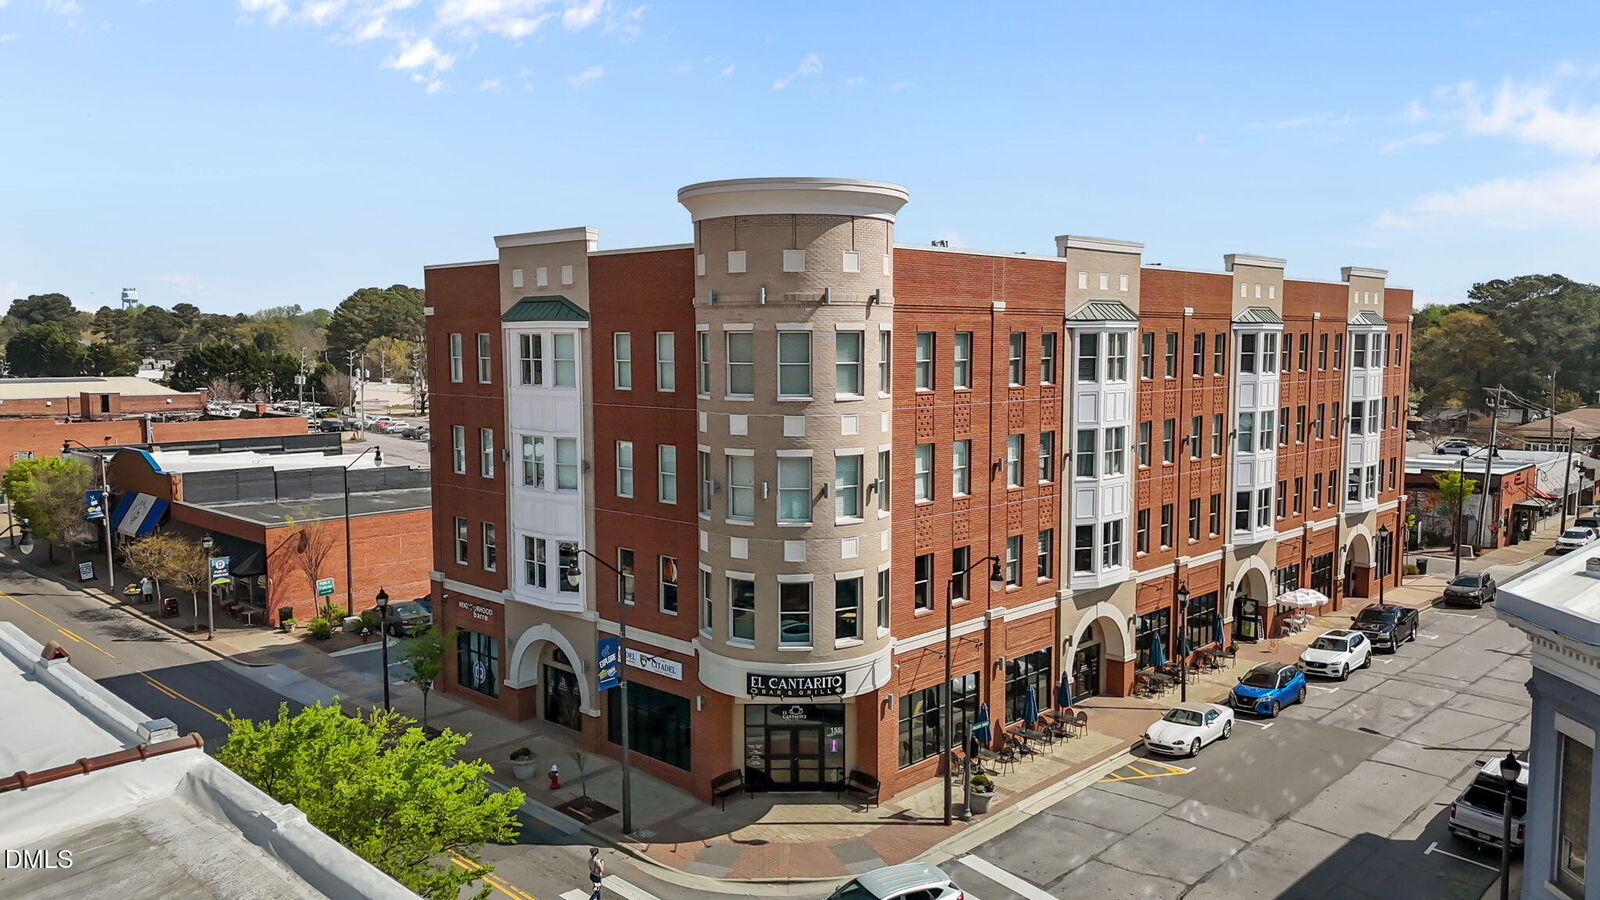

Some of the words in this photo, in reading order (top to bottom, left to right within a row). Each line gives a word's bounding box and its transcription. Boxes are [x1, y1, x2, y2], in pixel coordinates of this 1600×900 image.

[651, 661, 676, 674] CITADEL
[751, 676, 765, 688] EL
[768, 675, 842, 690] CANTARITO
